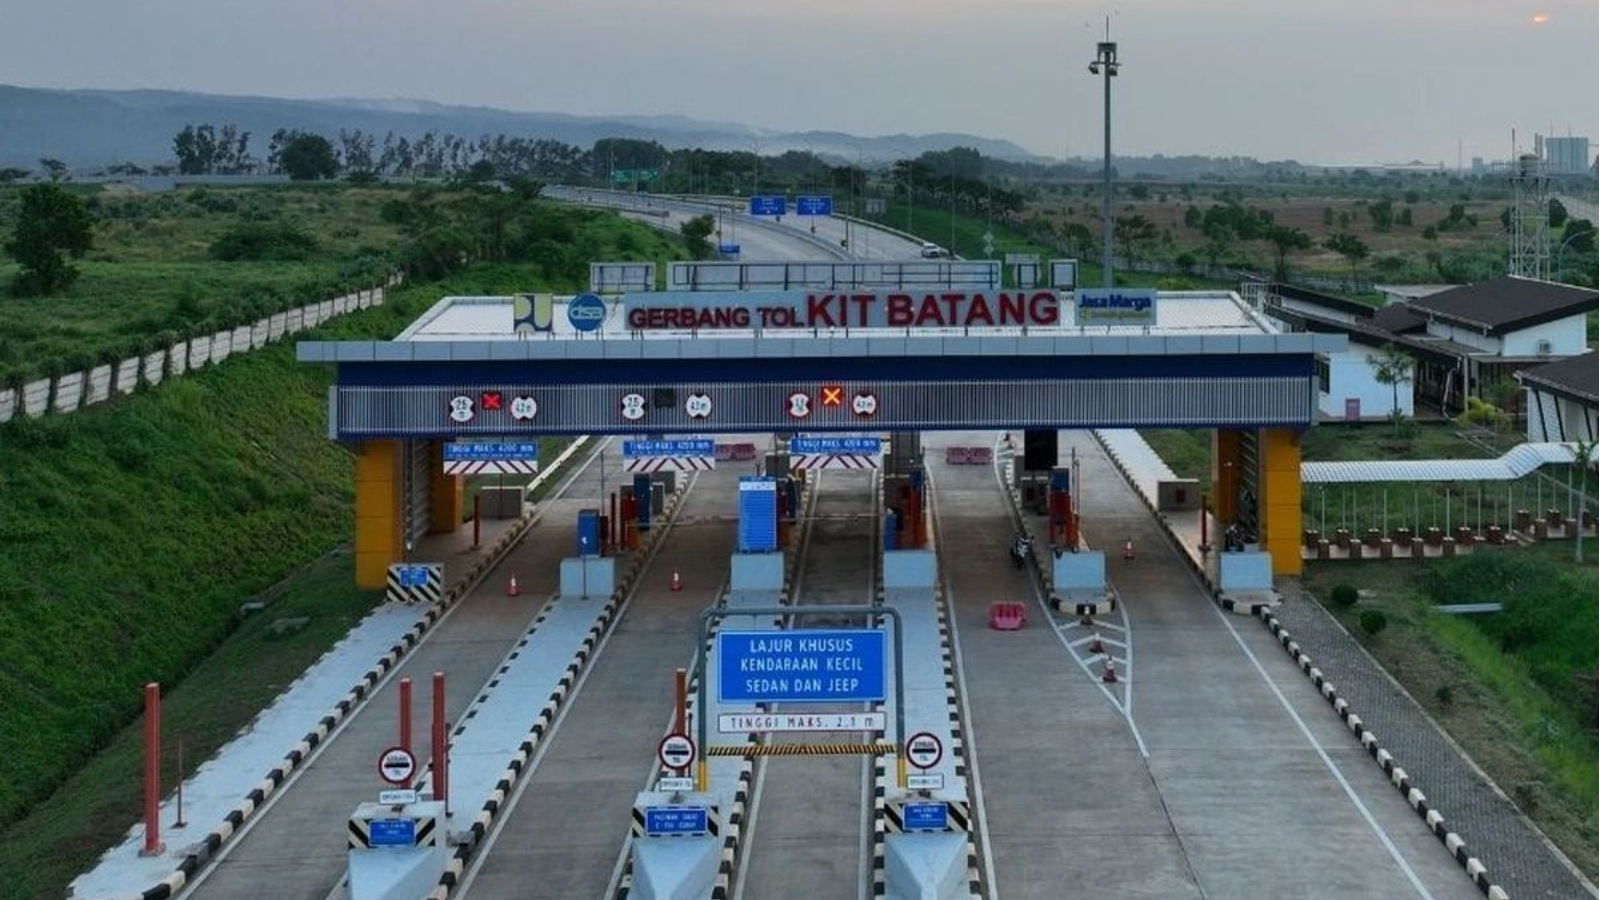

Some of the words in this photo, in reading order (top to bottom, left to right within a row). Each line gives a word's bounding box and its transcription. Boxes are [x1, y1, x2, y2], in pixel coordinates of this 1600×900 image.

[628, 306, 750, 329] GERBANG
[757, 306, 805, 328] TOL
[807, 294, 876, 328] KIT
[886, 291, 1059, 327] BATANG
[750, 638, 793, 653] LAJUR
[799, 637, 854, 653] KHUSUS
[740, 657, 819, 672] KENDARAAN
[826, 656, 863, 672] KECIL
[745, 678, 789, 693] SEDAN
[794, 678, 822, 692] DAN
[826, 677, 860, 692] JEEP
[730, 717, 779, 729] TINGGI
